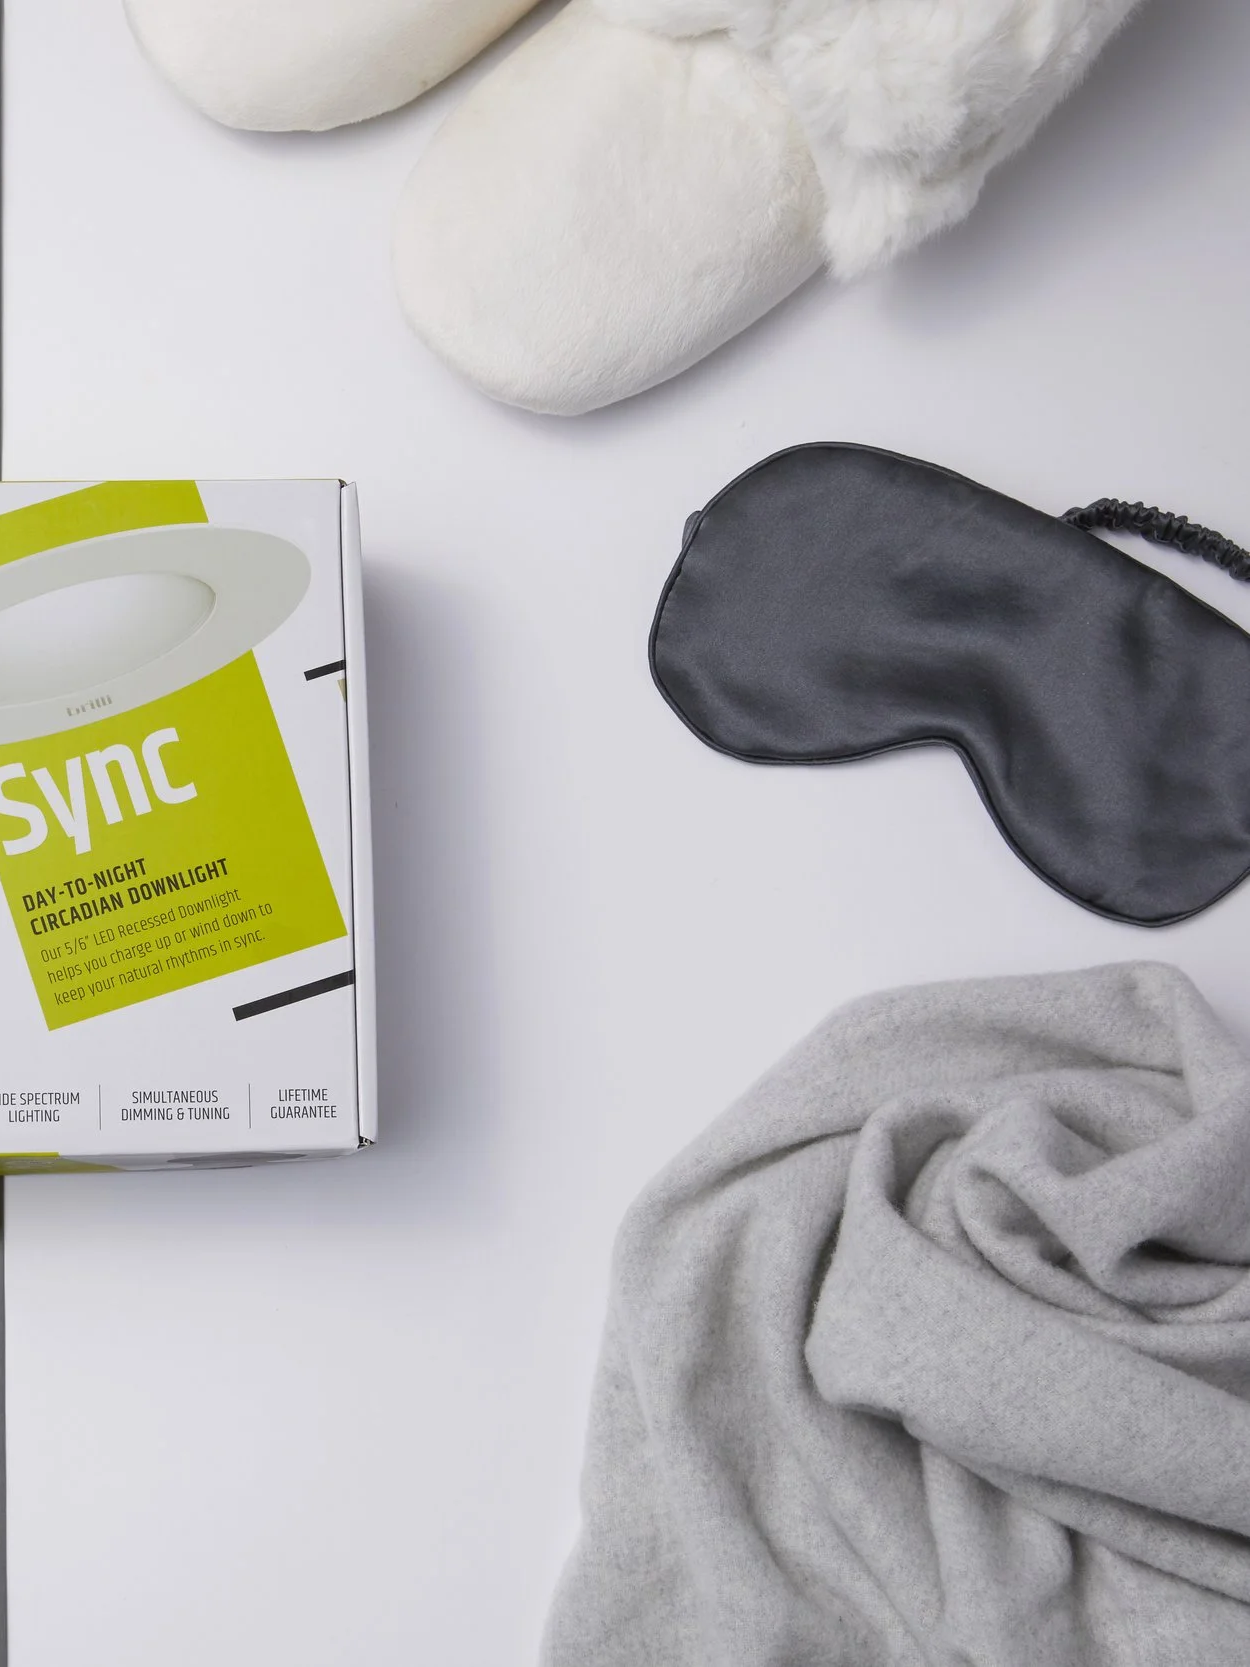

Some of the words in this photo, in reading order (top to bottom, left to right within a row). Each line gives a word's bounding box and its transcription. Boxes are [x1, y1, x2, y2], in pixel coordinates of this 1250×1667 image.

[21, 858, 148, 913] DAY-TO-NIGHT
[30, 890, 125, 936] CIRCADIAN
[127, 857, 230, 906] DOWNLIGHT
[40, 946, 62, 963] Our
[93, 927, 116, 946] LED
[118, 907, 177, 939] Recessed
[178, 888, 241, 919] Downlight
[47, 964, 83, 984] helps
[84, 955, 108, 974] you
[110, 941, 152, 964] charge
[155, 934, 171, 950] up
[174, 929, 186, 944] or
[189, 917, 220, 939] wind
[223, 908, 257, 928] down
[258, 903, 273, 917] to
[54, 986, 86, 1006] keep
[88, 976, 116, 997] your
[118, 959, 164, 985] natural
[165, 943, 218, 970] rhythms
[218, 939, 232, 953] in
[234, 929, 266, 948] sync.
[19, 1091, 80, 1106] SPECTRUM
[132, 1090, 219, 1105] SIMULTANEOUS
[278, 1088, 329, 1102] LIFETIME
[8, 1108, 61, 1123] LIGHTING
[121, 1107, 174, 1122] DIMMING
[176, 1107, 186, 1121] &
[188, 1106, 230, 1121] TUNING
[270, 1105, 337, 1119] GUARANTEE
